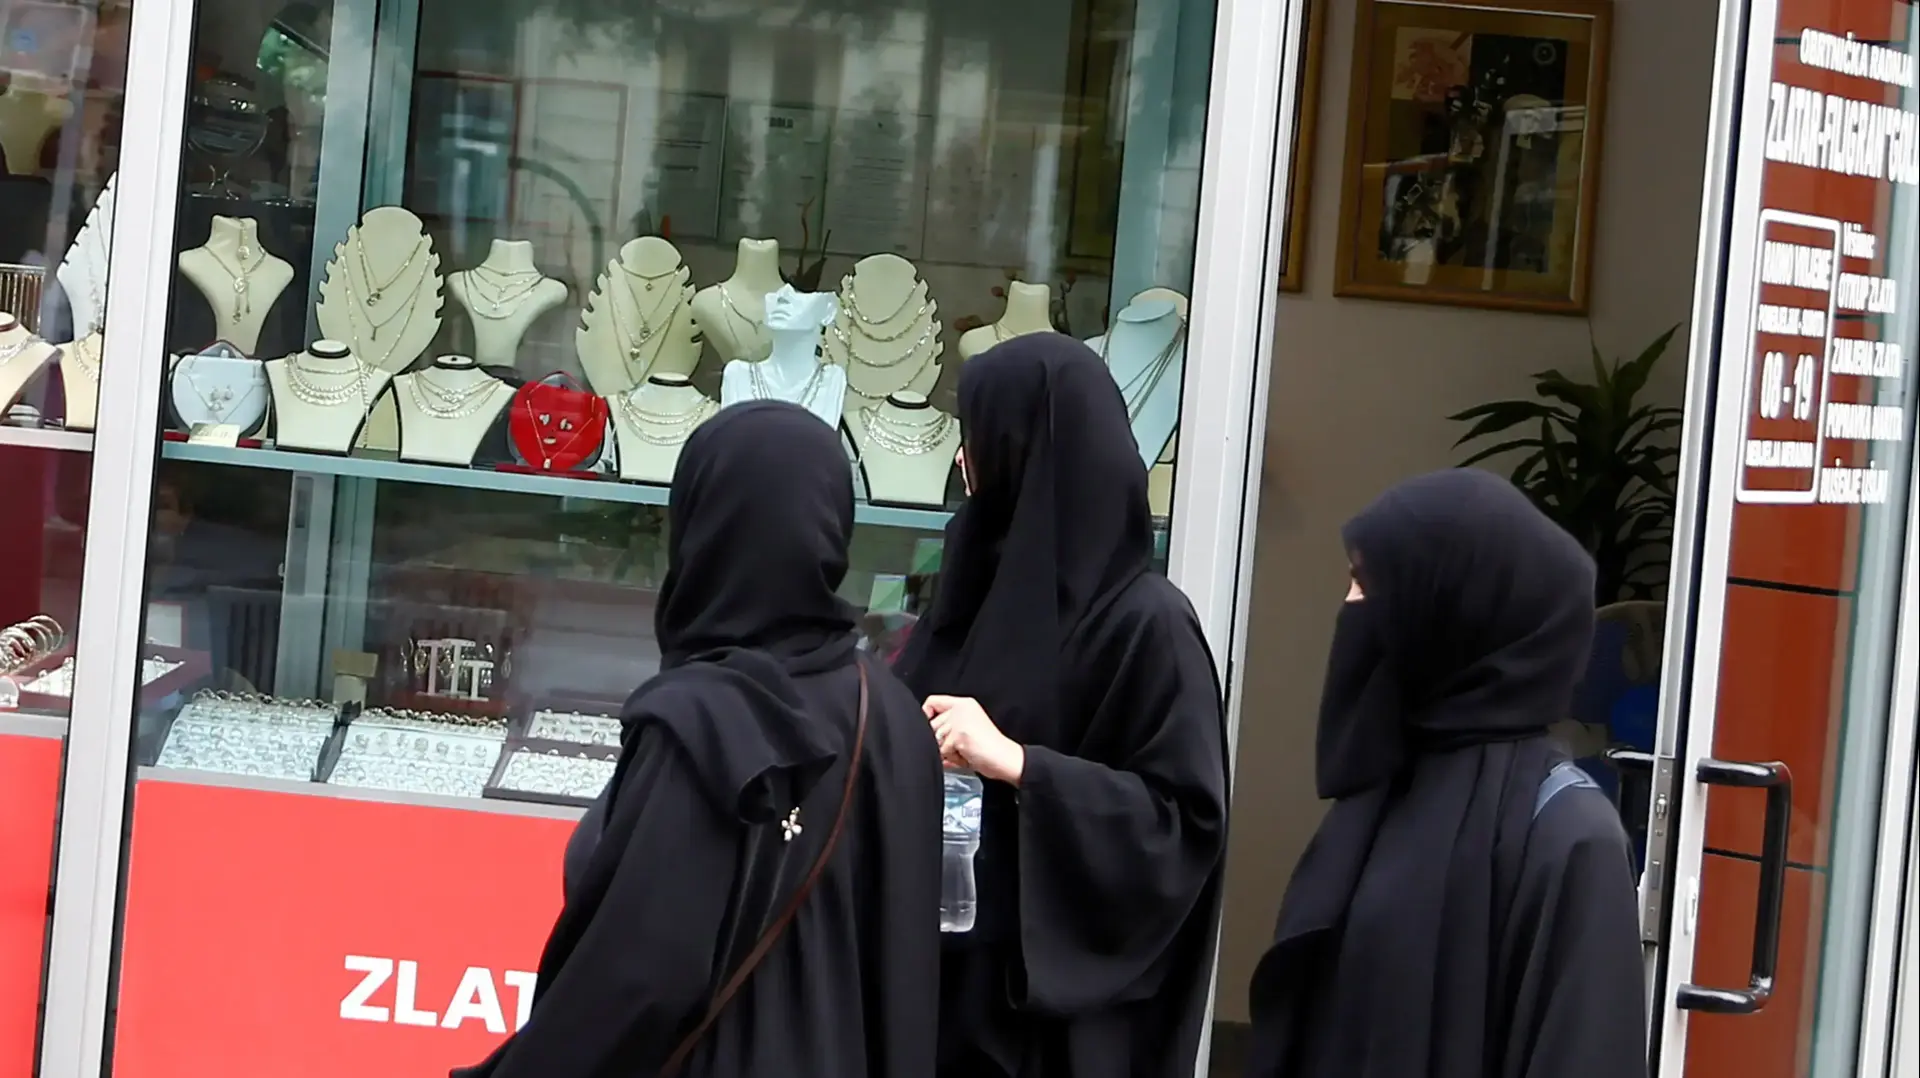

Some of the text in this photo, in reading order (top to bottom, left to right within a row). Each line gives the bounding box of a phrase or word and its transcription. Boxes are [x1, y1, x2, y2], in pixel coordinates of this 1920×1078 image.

[1800, 28, 1913, 88] OBRTNIČKA RADNJA
[1838, 273, 1869, 310] OTKUP
